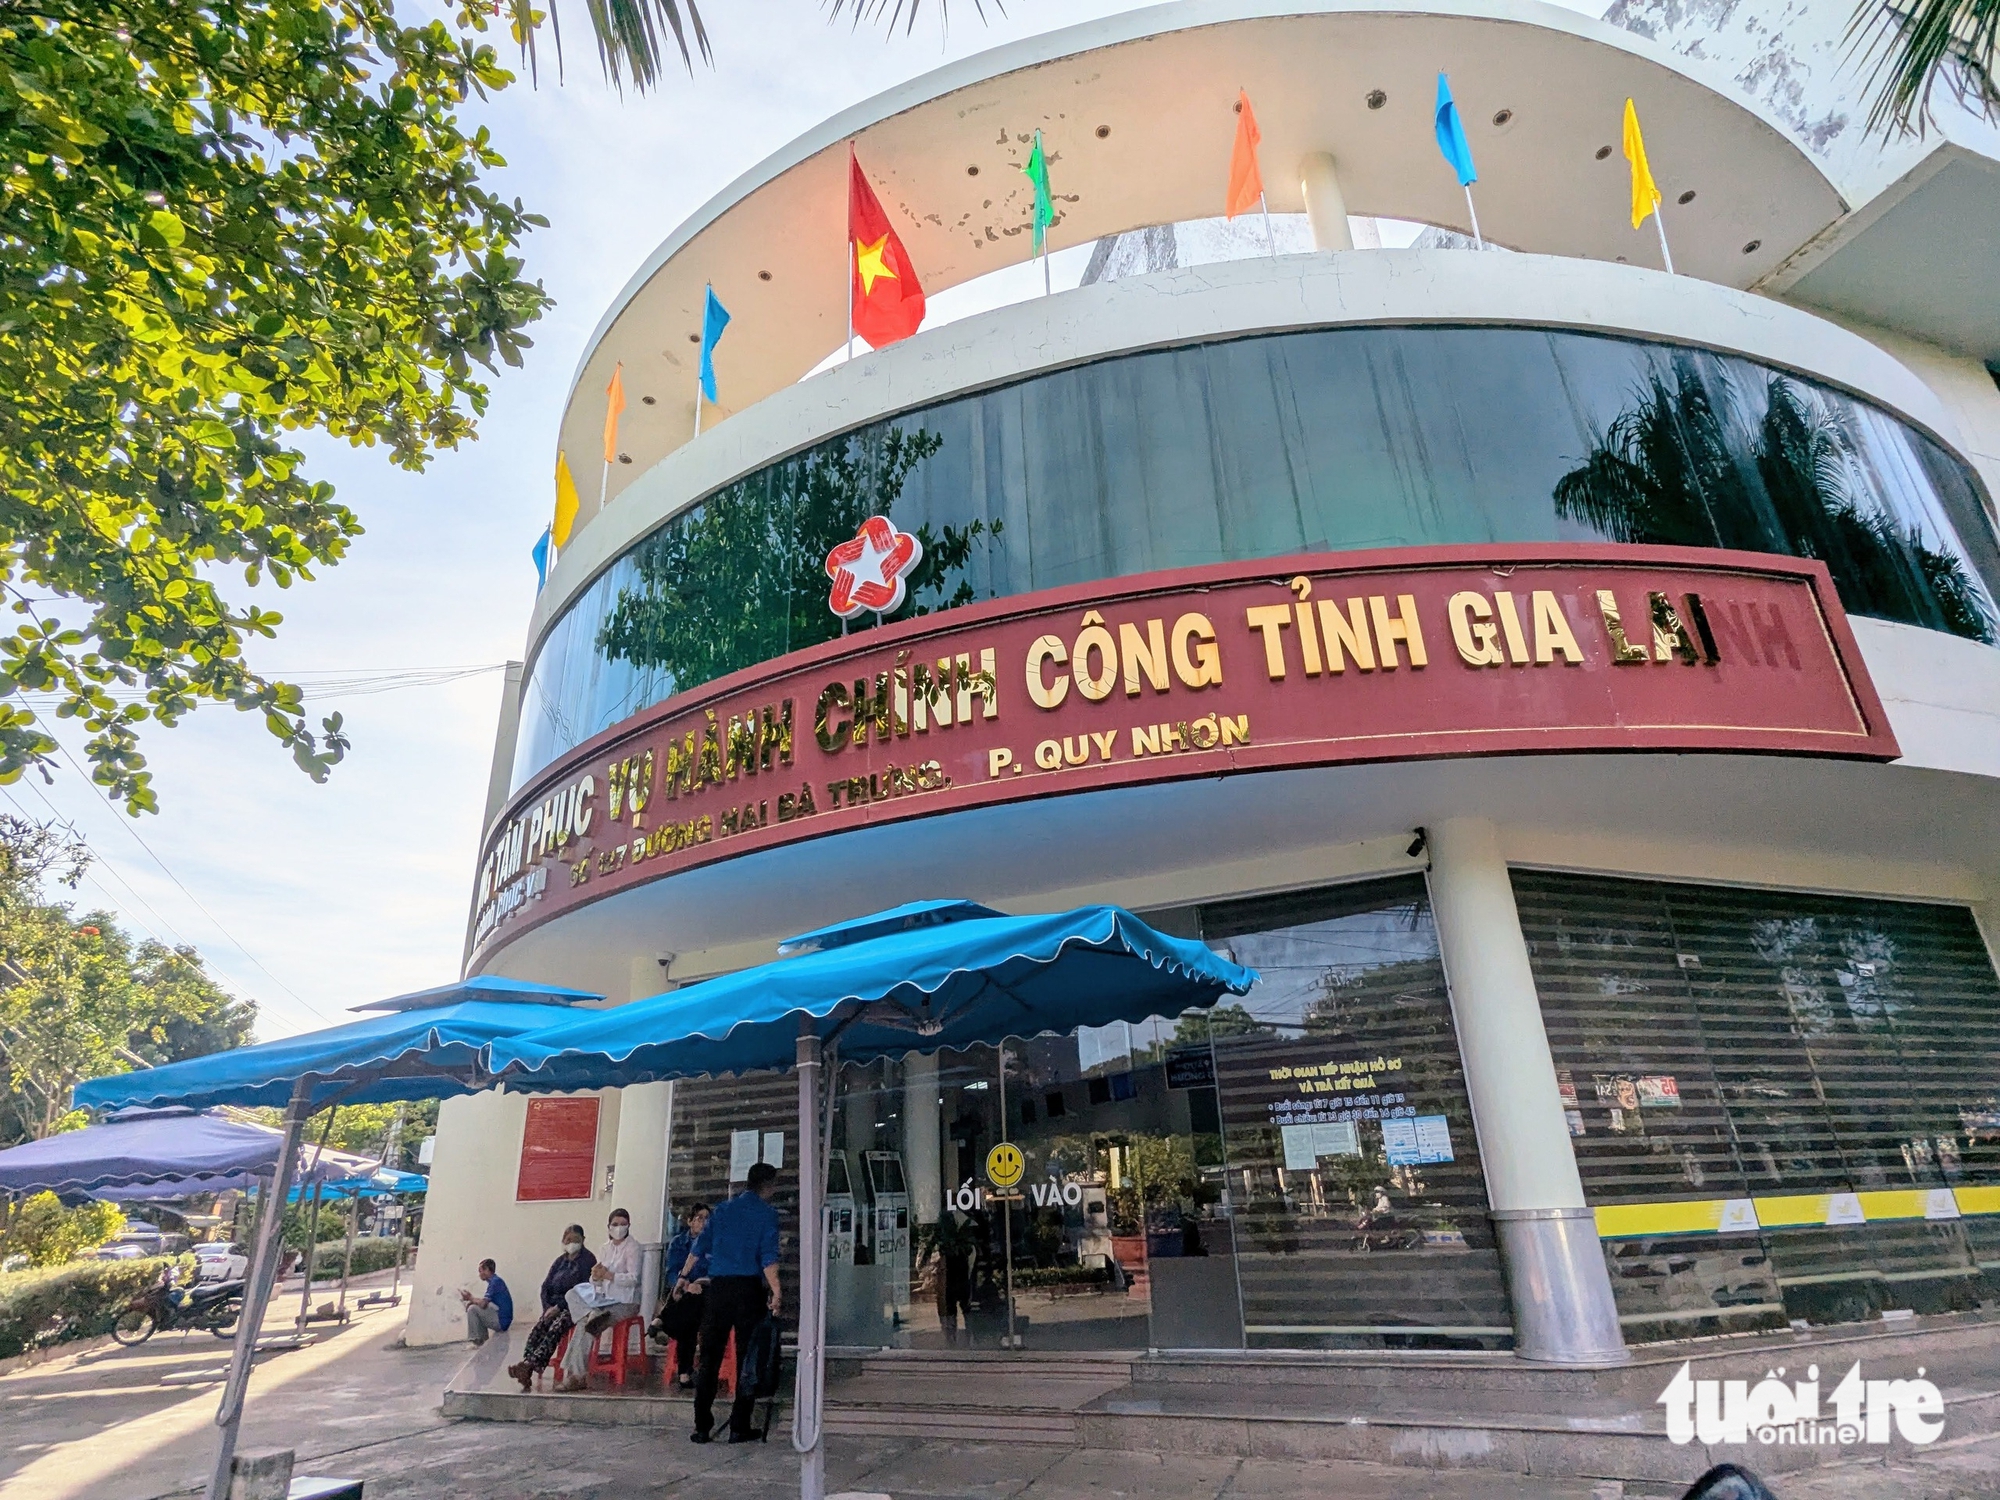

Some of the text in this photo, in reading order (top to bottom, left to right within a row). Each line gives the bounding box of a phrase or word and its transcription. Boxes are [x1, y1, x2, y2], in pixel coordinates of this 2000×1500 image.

[494, 819, 527, 892] TÂM
[527, 774, 595, 864] PHỤC
[608, 748, 653, 829] VỤ
[666, 699, 793, 800] HÀNH
[814, 649, 998, 752] CHÍNH
[1026, 610, 1224, 710] CÔNG
[1247, 575, 1428, 681] TỈNH
[1447, 590, 1585, 668] GIA
[1597, 589, 1721, 667] LAI
[720, 799, 768, 837] HAI
[778, 782, 818, 823] BÀ
[827, 759, 953, 808] TRƯNG,
[989, 747, 1022, 777] P.
[1035, 729, 1117, 772] QUY
[1131, 711, 1250, 756] NHƠN
[1269, 1066, 1292, 1080] THỜI
[1293, 1066, 1318, 1078] GIAN
[1339, 1060, 1369, 1075] NHẬN
[1369, 1056, 1386, 1072] HỒ
[1387, 1058, 1402, 1070] SƠ
[1298, 1074, 1376, 1093] VÀ TRẢ KẾT QUẢ
[946, 1174, 1082, 1211] LỐI VÀO
